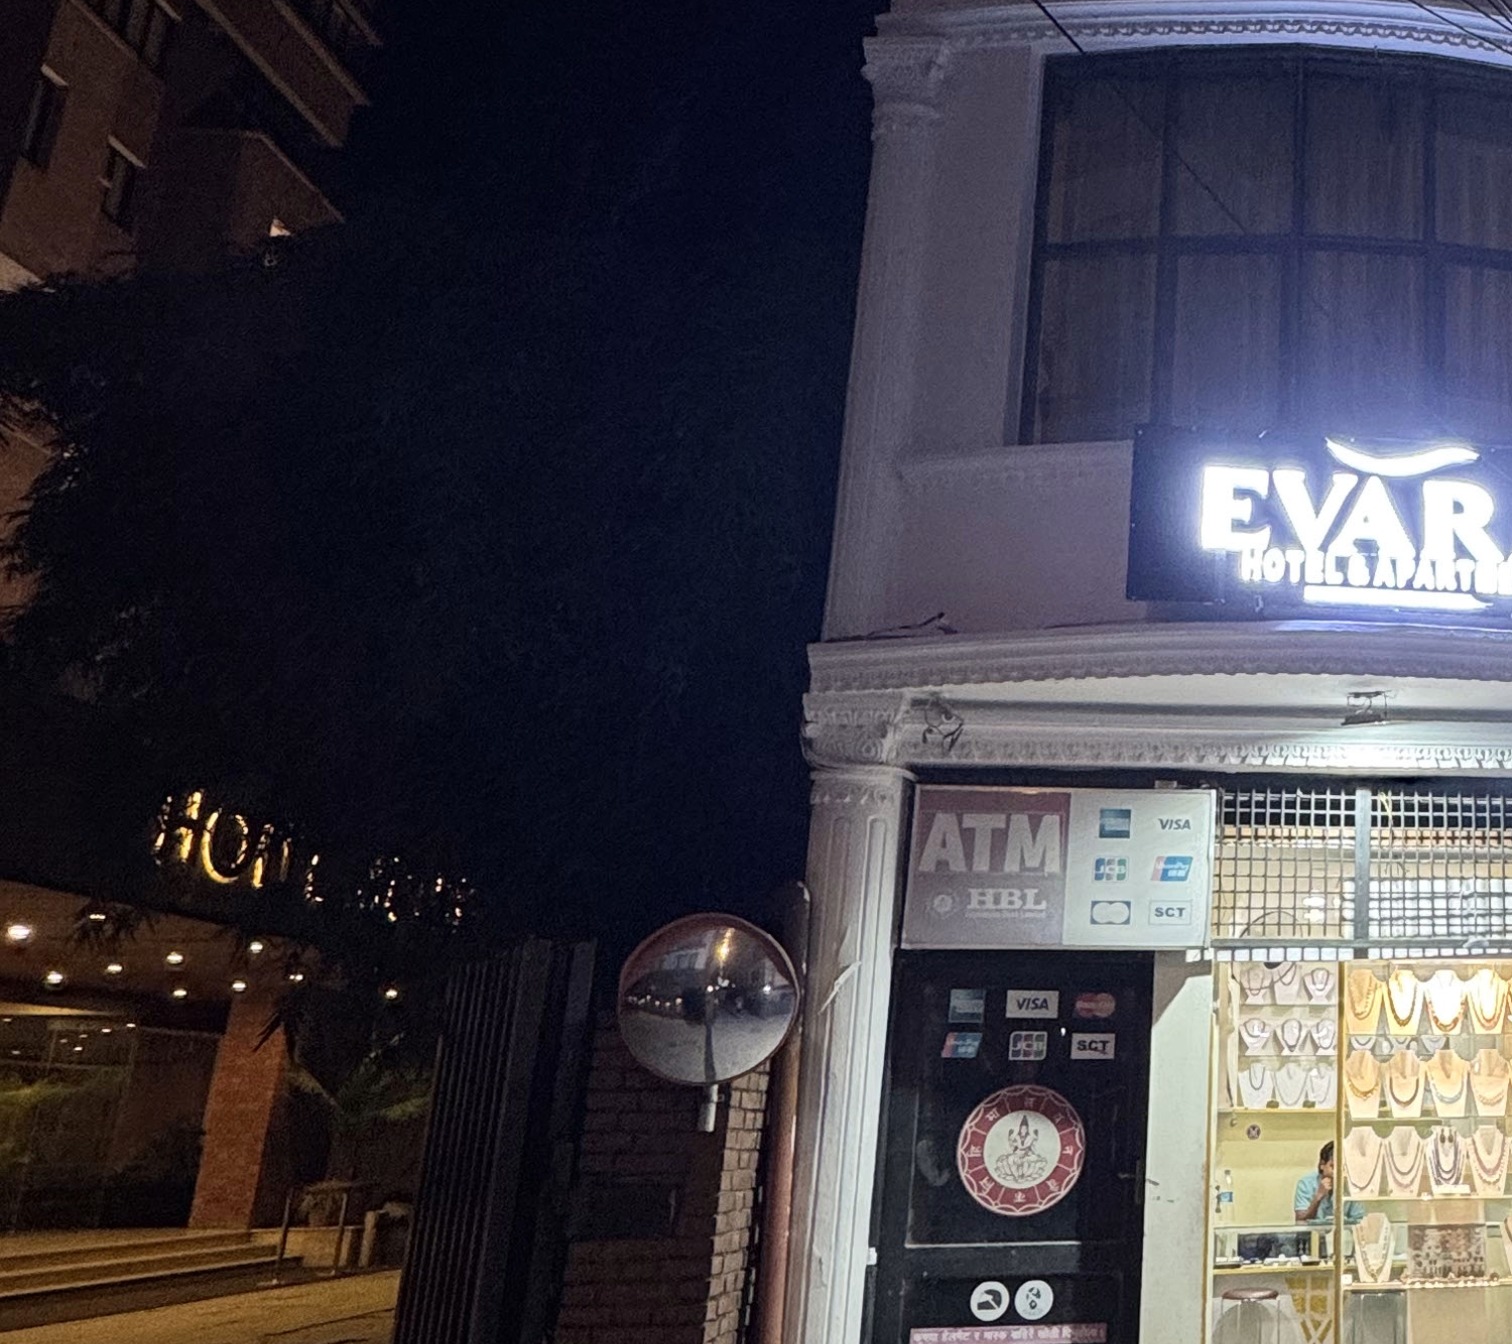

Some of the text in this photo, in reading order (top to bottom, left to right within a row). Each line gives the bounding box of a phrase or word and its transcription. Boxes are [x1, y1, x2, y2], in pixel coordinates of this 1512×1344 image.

[1240, 547, 1343, 586] HOTEL
[1158, 818, 1191, 830] VISA
[918, 812, 1061, 874] ATM
[966, 887, 1047, 910] HBL
[1155, 907, 1186, 918] SCT
[1016, 998, 1049, 1011] VISA
[1077, 1040, 1110, 1053] SCT
